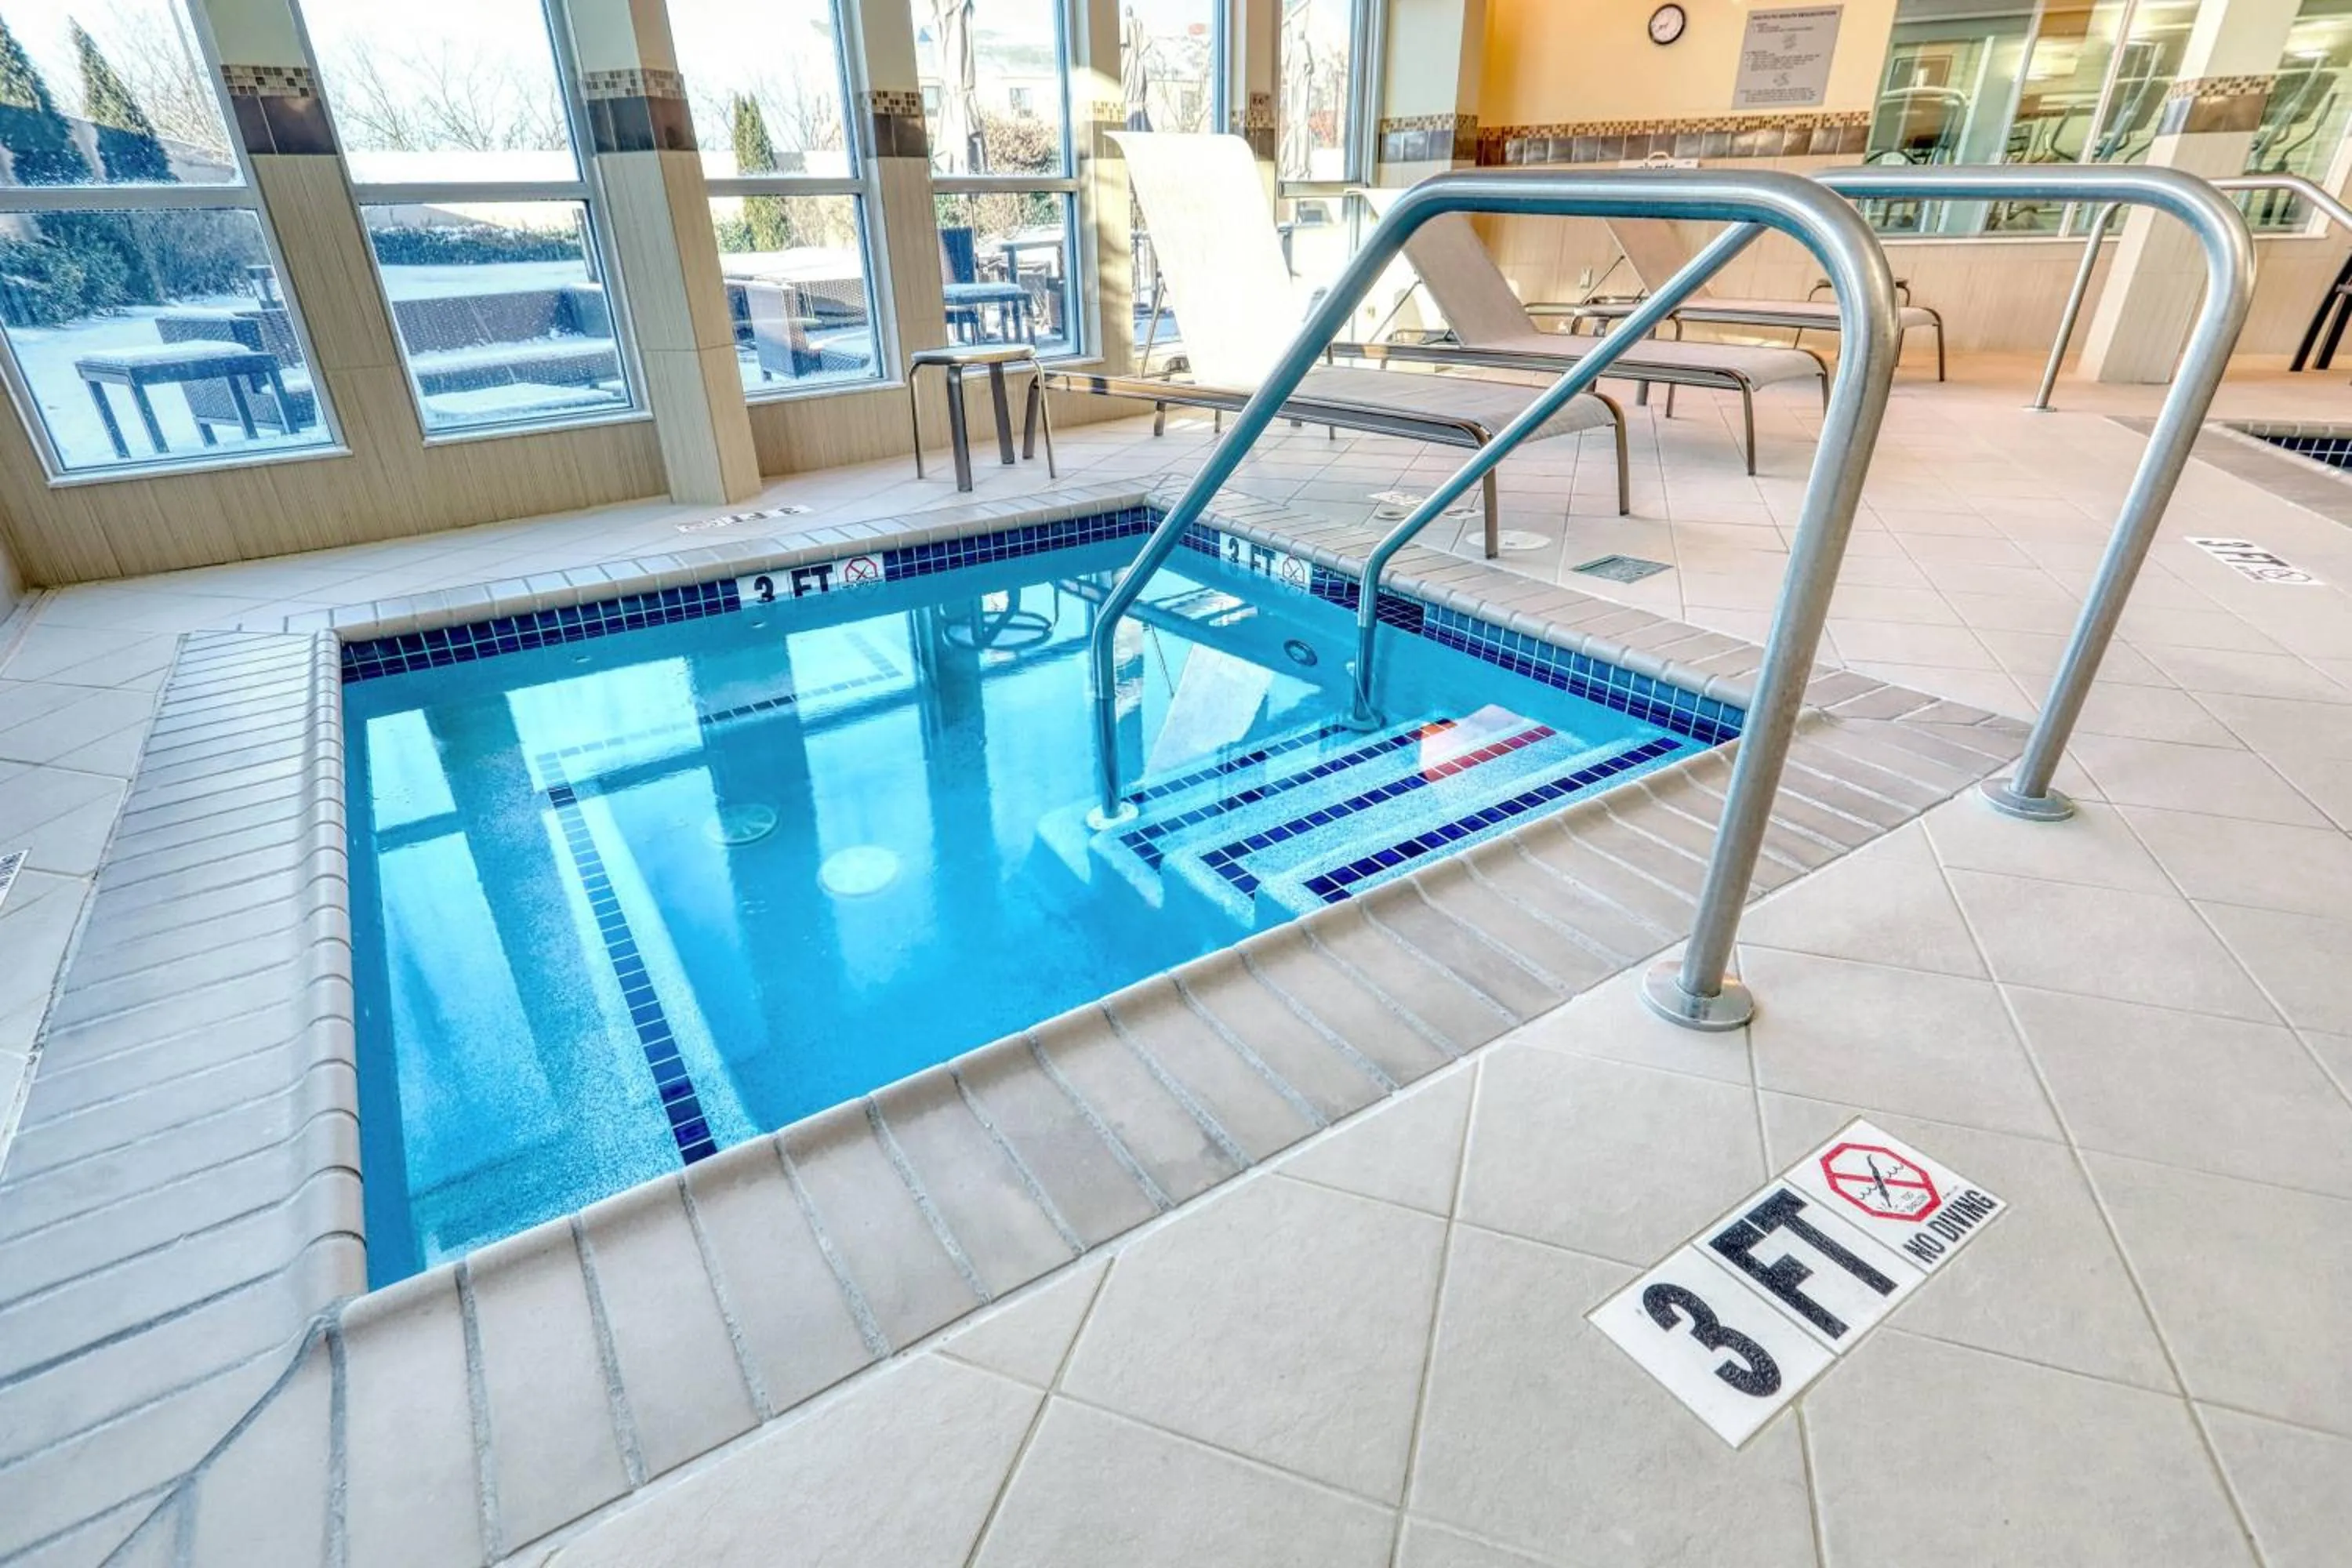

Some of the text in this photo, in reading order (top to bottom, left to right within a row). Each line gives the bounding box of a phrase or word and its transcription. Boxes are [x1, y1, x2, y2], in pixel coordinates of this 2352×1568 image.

[753, 564, 833, 603] 3 FT
[1228, 537, 1277, 576] 3 FT
[1902, 1232, 1947, 1265] NO
[1926, 1189, 1998, 1243] DIVING
[1642, 1187, 1899, 1398] 3 FT
